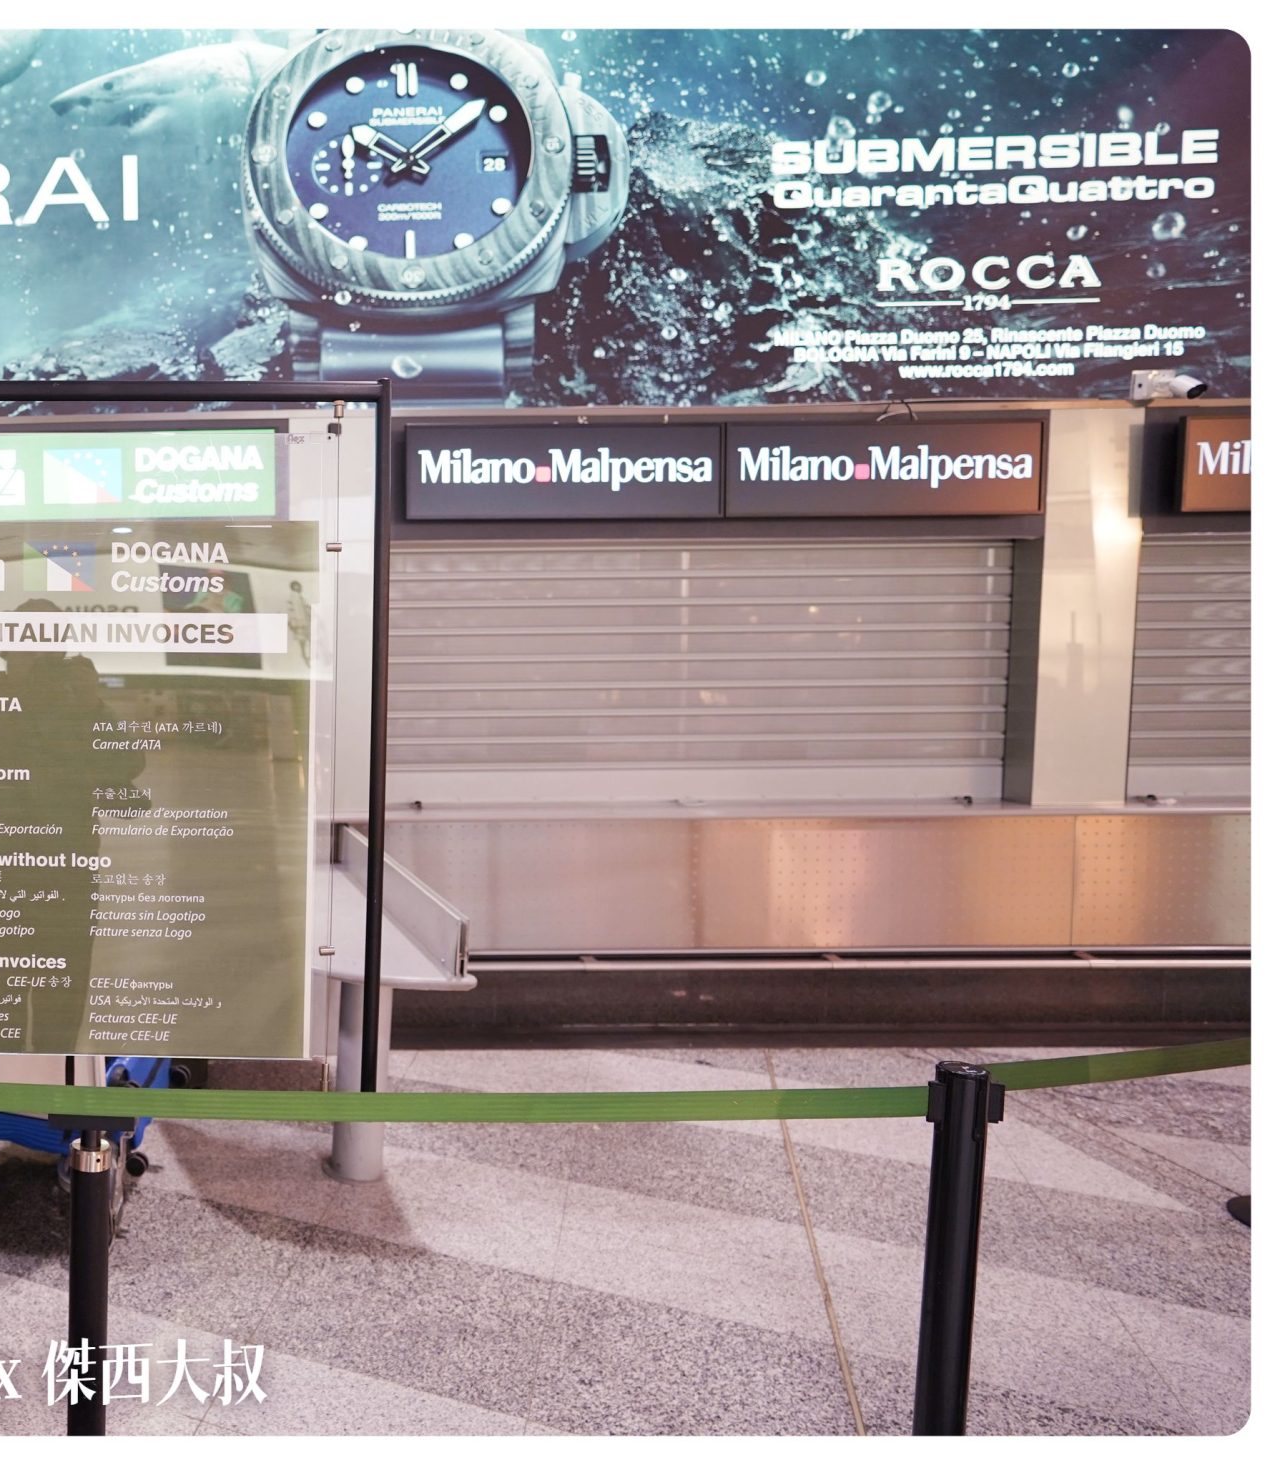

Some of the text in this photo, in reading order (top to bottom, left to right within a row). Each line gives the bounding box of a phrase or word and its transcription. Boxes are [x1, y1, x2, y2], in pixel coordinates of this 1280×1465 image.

[372, 106, 443, 118] PANERAI
[771, 129, 1219, 175] SUBMERSIBLE
[483, 157, 505, 172] 28
[773, 175, 1215, 209] QuarantaQuattro
[877, 254, 1102, 292] ROCCA
[962, 294, 1012, 311] 1794
[774, 323, 1206, 347] MILANO Piazza Duomo 25, Rinascente Piazza Duomo
[793, 346, 879, 363] BOLOGNA
[881, 346, 907, 362] Via
[910, 345, 957, 361] Farini
[959, 344, 971, 361] 9
[986, 343, 1052, 360] NAPOLI
[1054, 343, 1081, 359] Via
[1083, 341, 1160, 361] Filangieri
[1164, 340, 1185, 357] 15
[898, 360, 1075, 379] www.rocca1794.com
[134, 444, 264, 473] DOGANA
[136, 478, 260, 505] Customs
[111, 541, 230, 564] DOGANA
[111, 571, 225, 593] Customs
[107, 622, 235, 645] INVOICES
[92, 722, 114, 732] ATA
[92, 739, 129, 750] Carnet
[91, 806, 152, 819] Formulaire
[91, 824, 234, 839] Formulario de Exportação
[71, 852, 112, 871] logo
[90, 892, 205, 904] Фактуры без логотипа
[89, 909, 206, 924] Facturas sin Logotipo
[89, 925, 193, 941] Fatture senza Logo
[6, 976, 47, 988] CEE-UE
[89, 995, 111, 1006] USA
[89, 1012, 179, 1025] Facturas CEE-UE
[0, 1027, 22, 1039] CEE
[88, 1029, 171, 1042] Fatture CEE-UE
